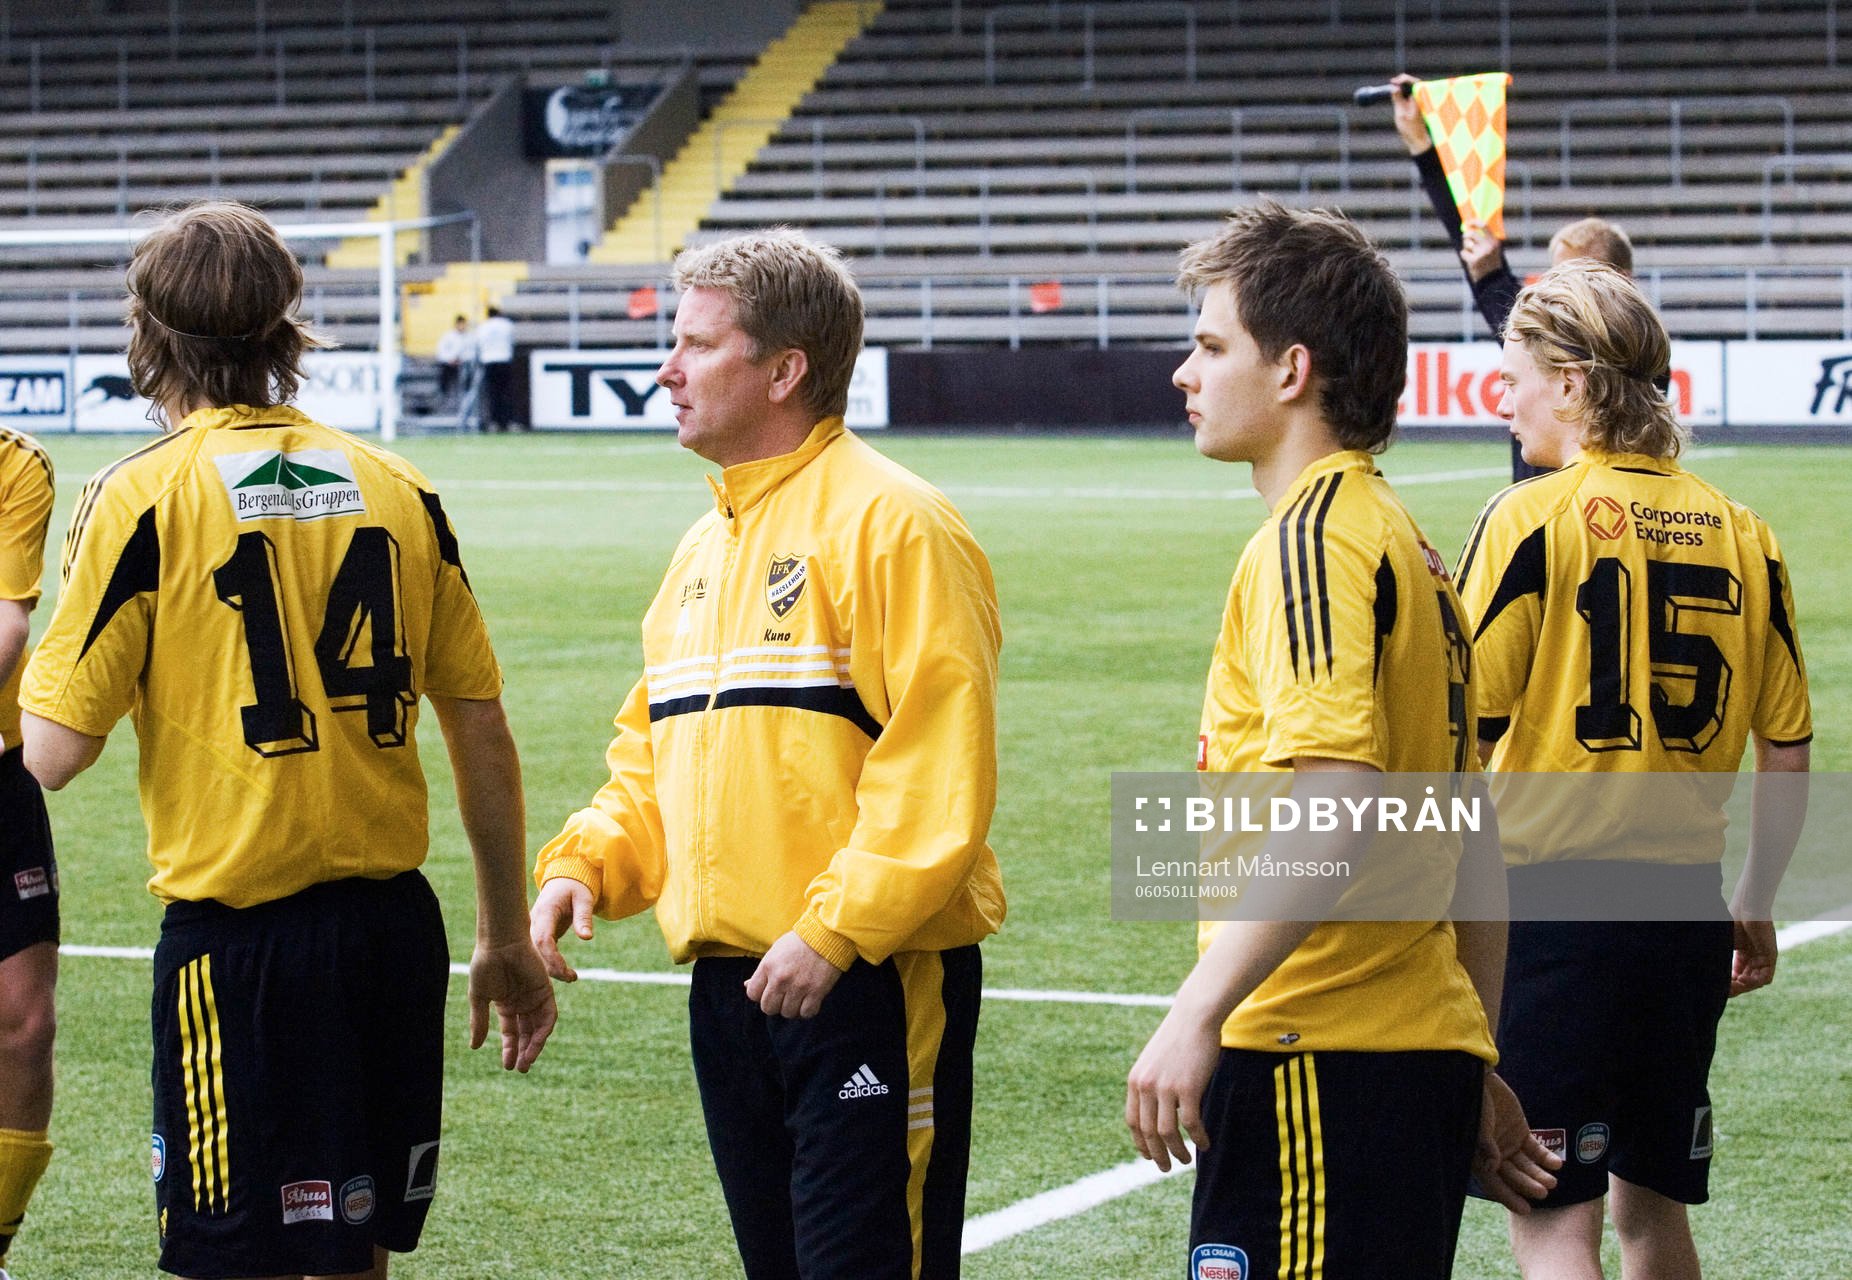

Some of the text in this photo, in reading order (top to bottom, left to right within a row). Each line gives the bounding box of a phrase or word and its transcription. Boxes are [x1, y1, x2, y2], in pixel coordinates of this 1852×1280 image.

[1631, 501, 1722, 529] Corporate
[1634, 521, 1704, 546] Express
[213, 526, 417, 758] 14
[764, 628, 791, 642] Kuno
[1576, 557, 1742, 754] 15
[839, 1084, 889, 1100] adidas
